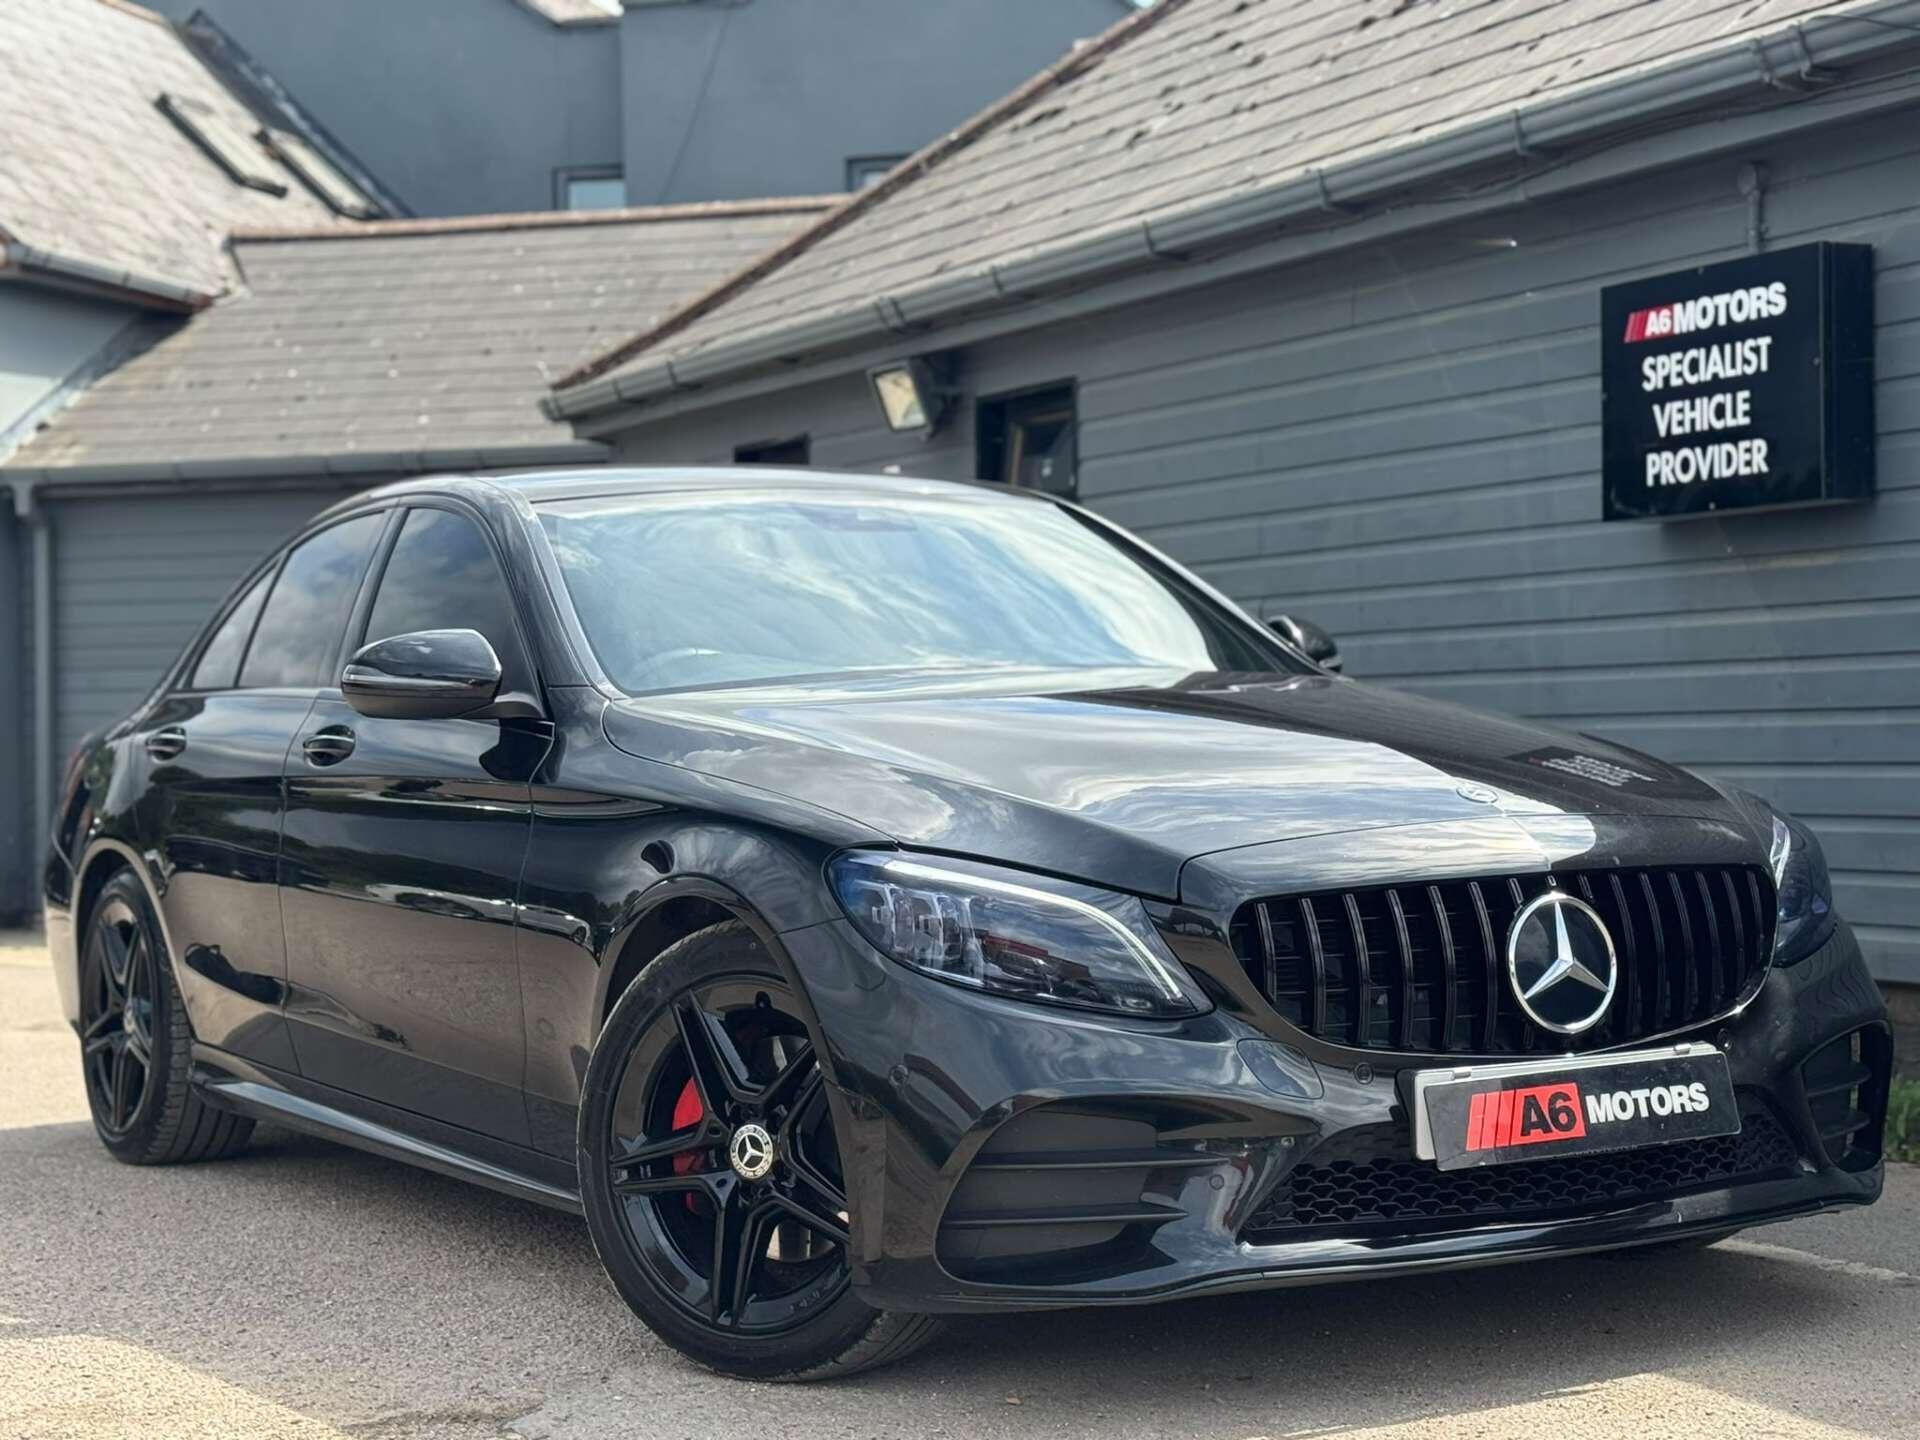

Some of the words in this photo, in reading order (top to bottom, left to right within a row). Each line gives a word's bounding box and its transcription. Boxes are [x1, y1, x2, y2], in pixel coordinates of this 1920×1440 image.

[1642, 336, 1772, 391] SPECIALIST
[1652, 390, 1751, 438] VEHICLE
[1646, 438, 1769, 487] PROVIDER
[1520, 1091, 1577, 1137] A6
[1585, 1081, 1710, 1125] MOTORS
